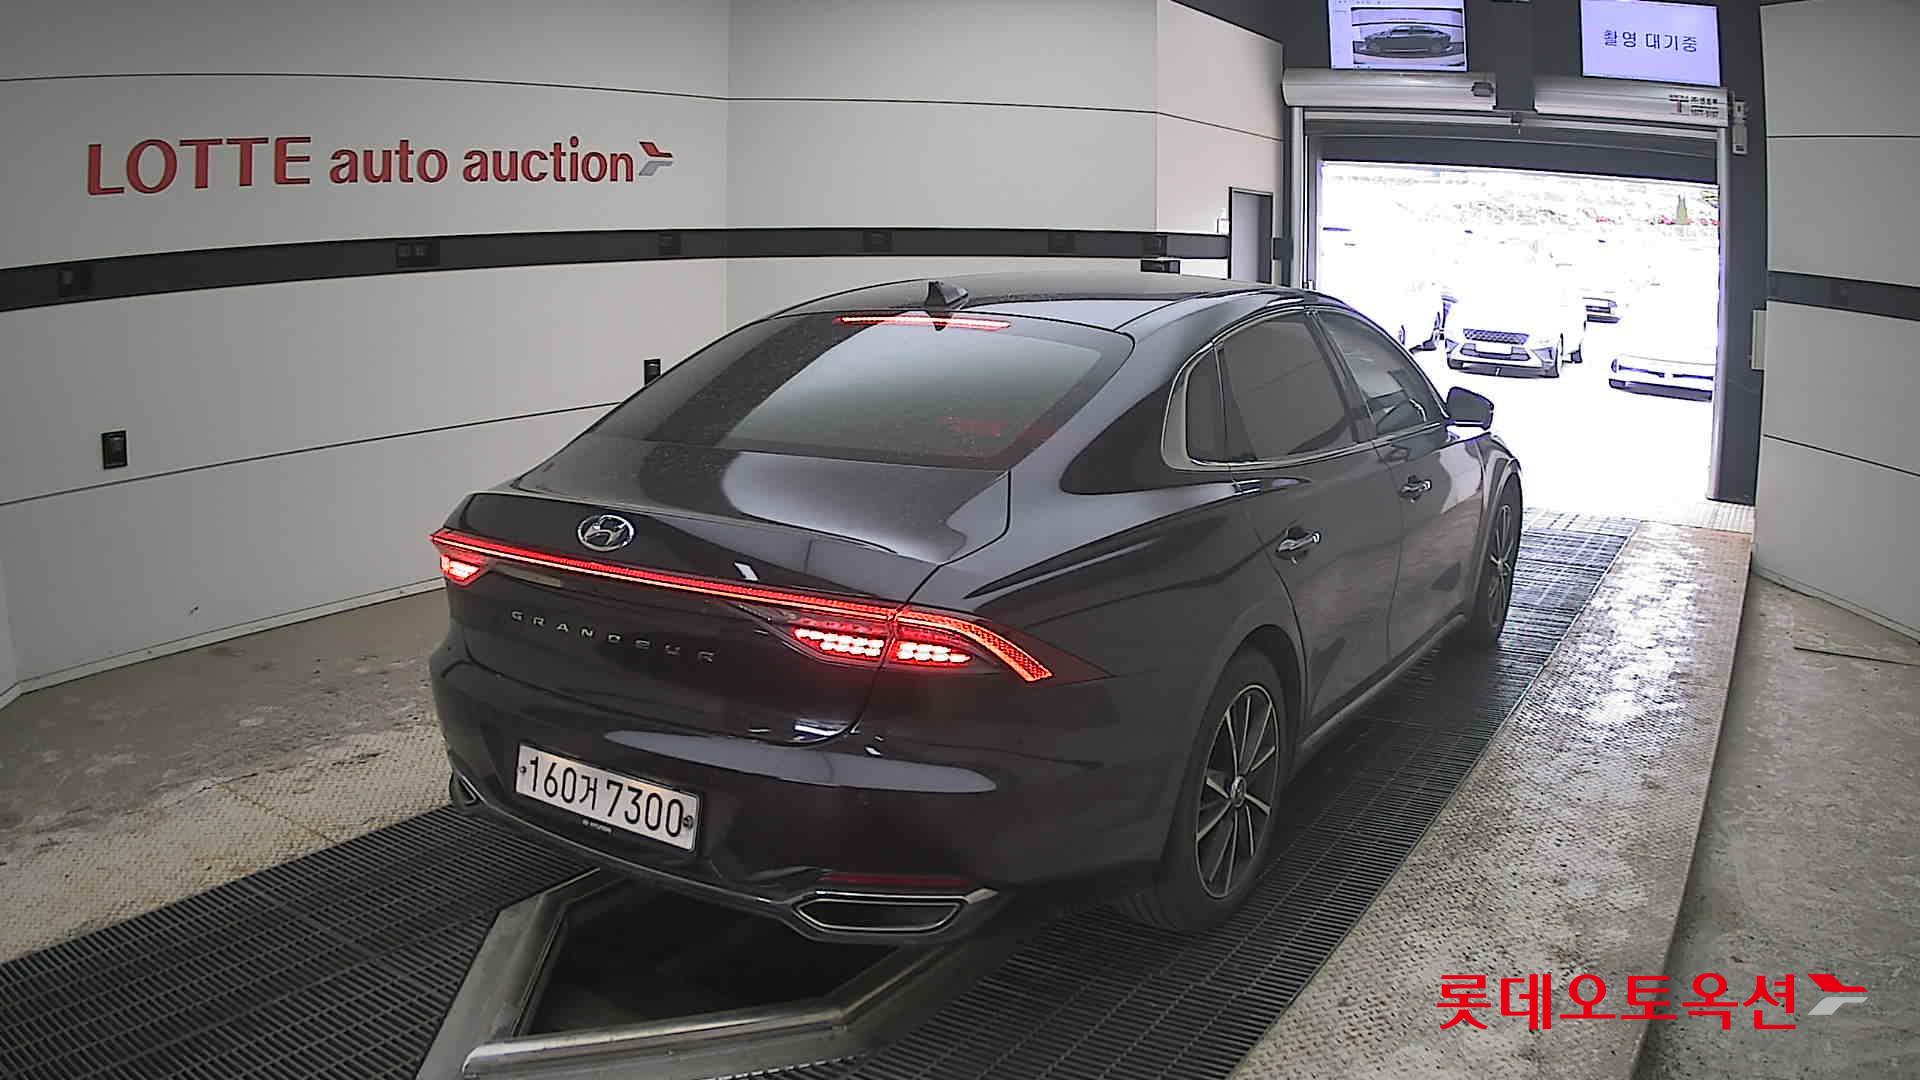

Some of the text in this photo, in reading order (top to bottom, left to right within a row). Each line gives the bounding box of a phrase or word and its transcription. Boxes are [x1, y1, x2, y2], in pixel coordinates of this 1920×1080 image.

[1604, 30, 1697, 53] 촬영 대기중
[87, 136, 634, 196] LOTTE auto auction
[511, 610, 715, 663] GRANDEUR
